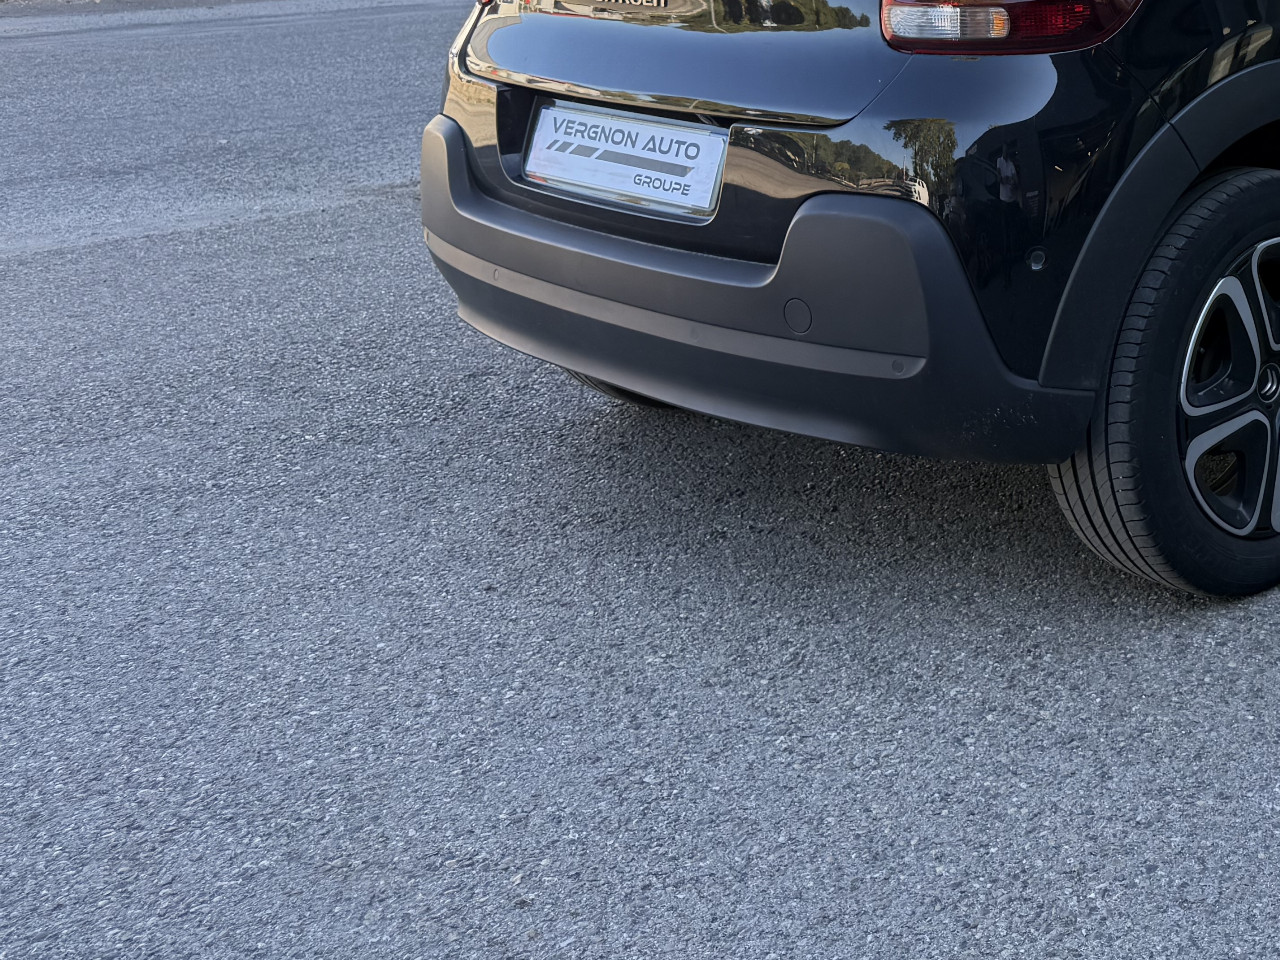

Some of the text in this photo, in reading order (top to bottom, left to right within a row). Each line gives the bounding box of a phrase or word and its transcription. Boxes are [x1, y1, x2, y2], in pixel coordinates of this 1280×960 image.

[553, 116, 701, 160] VERGNON AUTO
[633, 173, 692, 196] GROUPE
